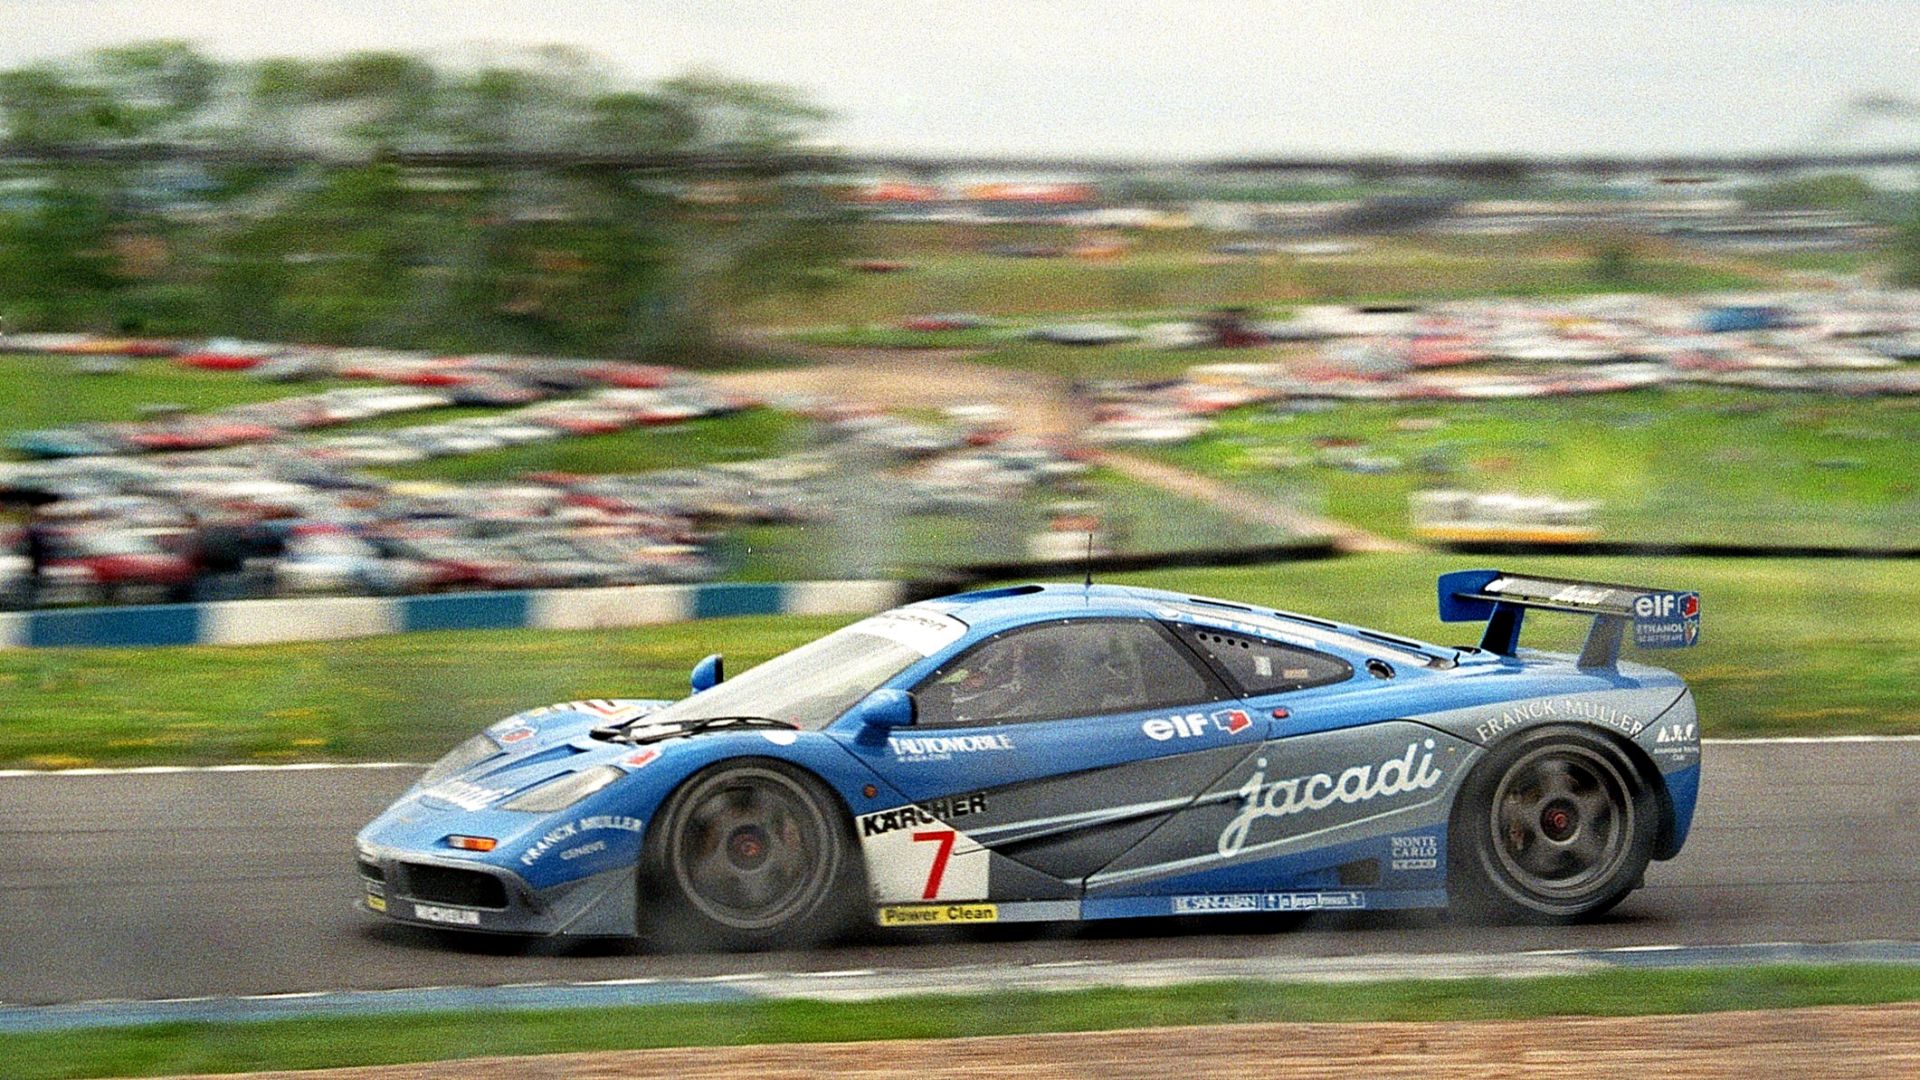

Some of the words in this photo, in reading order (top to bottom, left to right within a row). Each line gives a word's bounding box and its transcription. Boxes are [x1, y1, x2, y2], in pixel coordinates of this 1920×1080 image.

[1636, 595, 1675, 617] elf
[1142, 713, 1209, 741] elf
[1476, 700, 1556, 742] FRANCK
[1565, 699, 1643, 740] MULLER
[1218, 739, 1443, 857] jacadi
[520, 822, 577, 866] FRANCK
[1391, 836, 1437, 847] MONTE
[1392, 847, 1437, 857] CARLO
[912, 830, 955, 900] 7
[884, 909, 940, 922] Power
[946, 906, 993, 920] Clean
